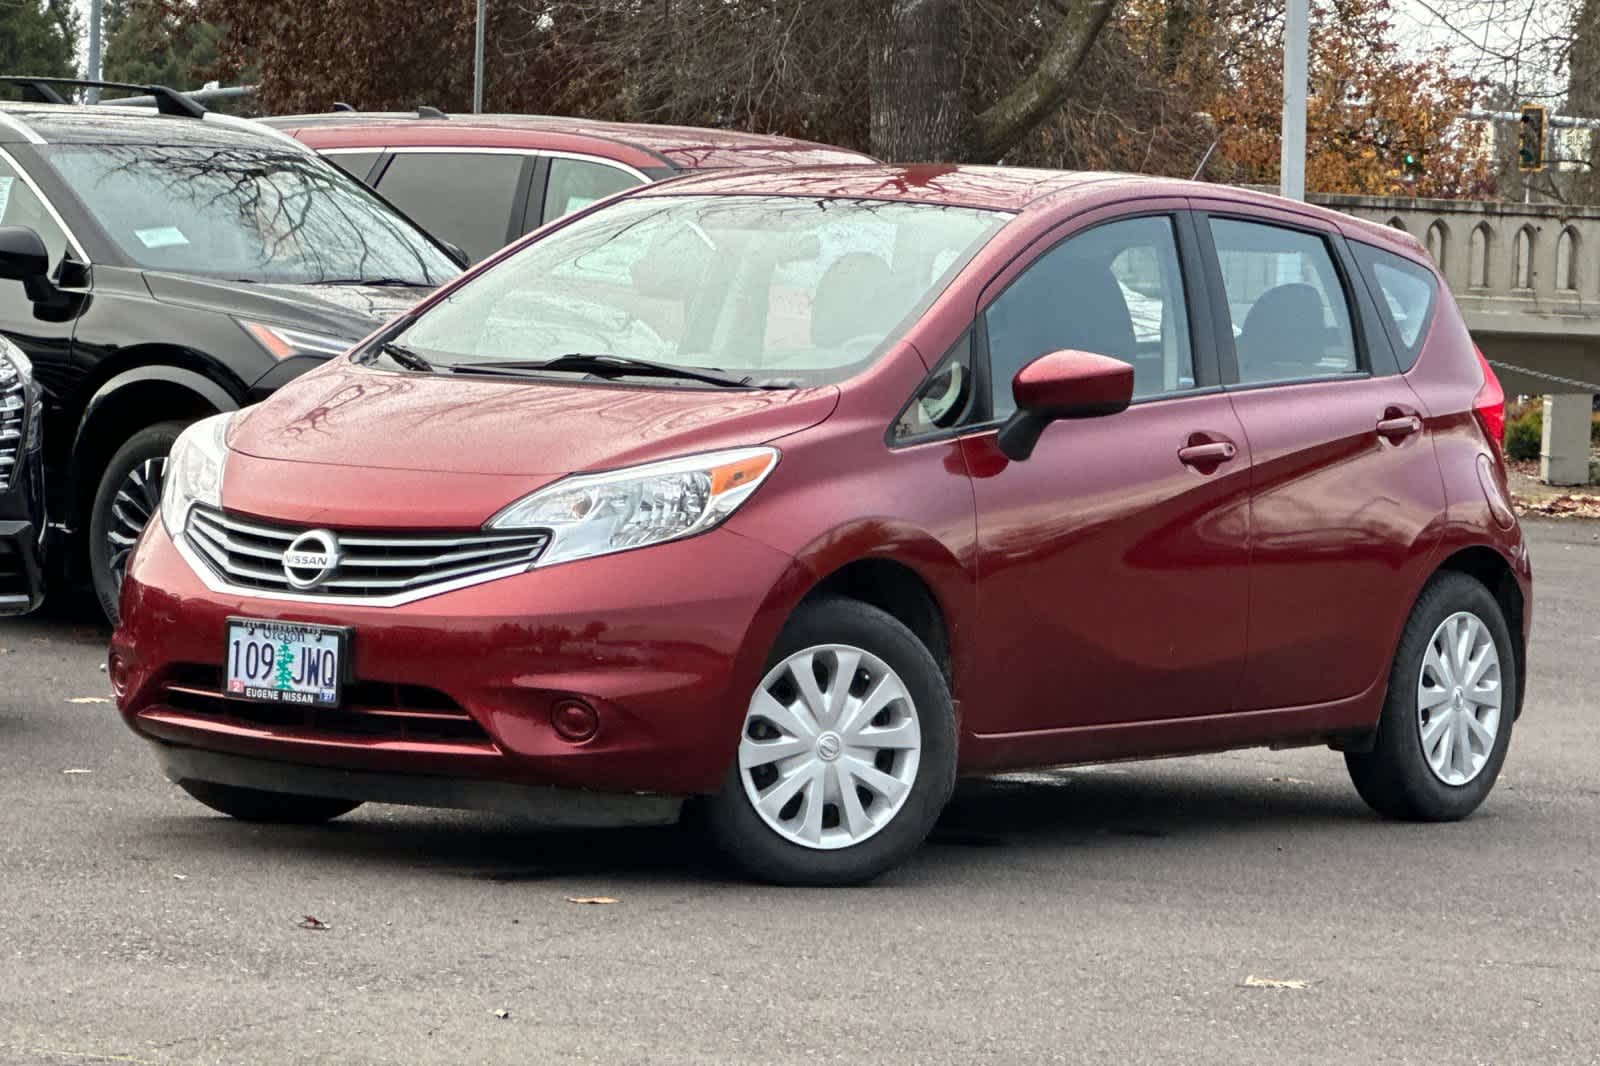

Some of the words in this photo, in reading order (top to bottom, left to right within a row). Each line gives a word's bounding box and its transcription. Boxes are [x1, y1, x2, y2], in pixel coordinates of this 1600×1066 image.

[286, 555, 328, 566] NISSAN
[263, 628, 305, 644] Oregon
[233, 640, 274, 680] 109
[292, 646, 335, 688] JWQ
[246, 688, 279, 700] EUGENE
[281, 691, 313, 704] NISSAN
